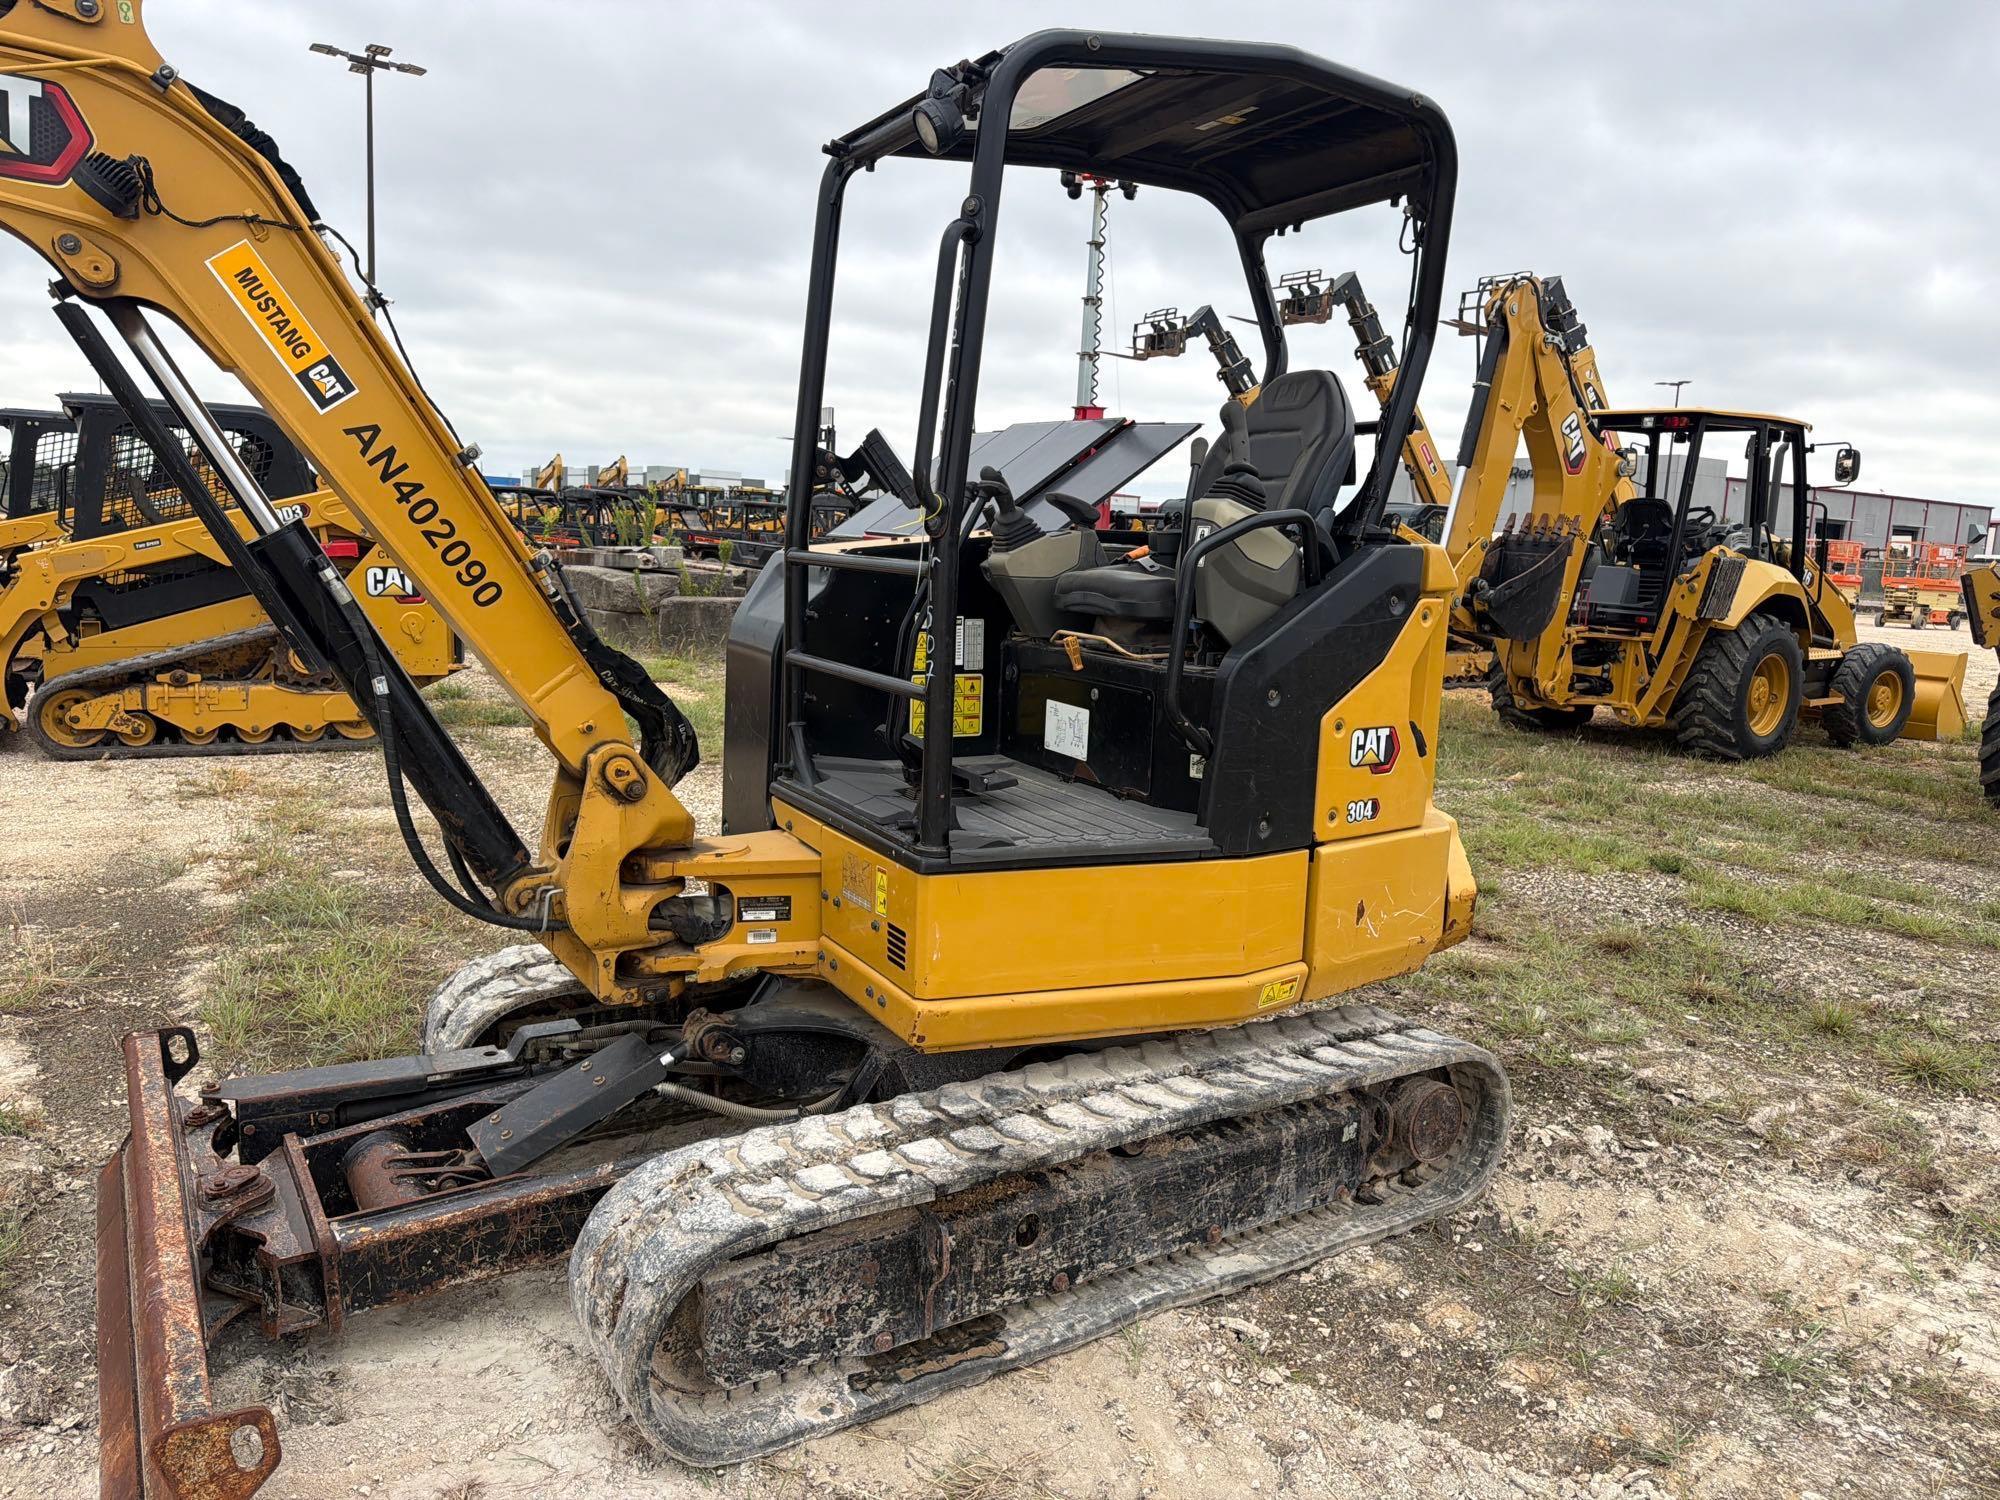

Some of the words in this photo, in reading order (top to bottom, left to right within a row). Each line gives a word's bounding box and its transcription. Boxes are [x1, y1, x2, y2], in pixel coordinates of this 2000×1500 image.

[234, 266, 312, 360] MUSTANG
[308, 363, 345, 399] CAT
[1561, 411, 1586, 462] CAT
[342, 424, 503, 607] AN402090
[1350, 727, 1390, 766] CAT
[1347, 800, 1373, 822] 304
